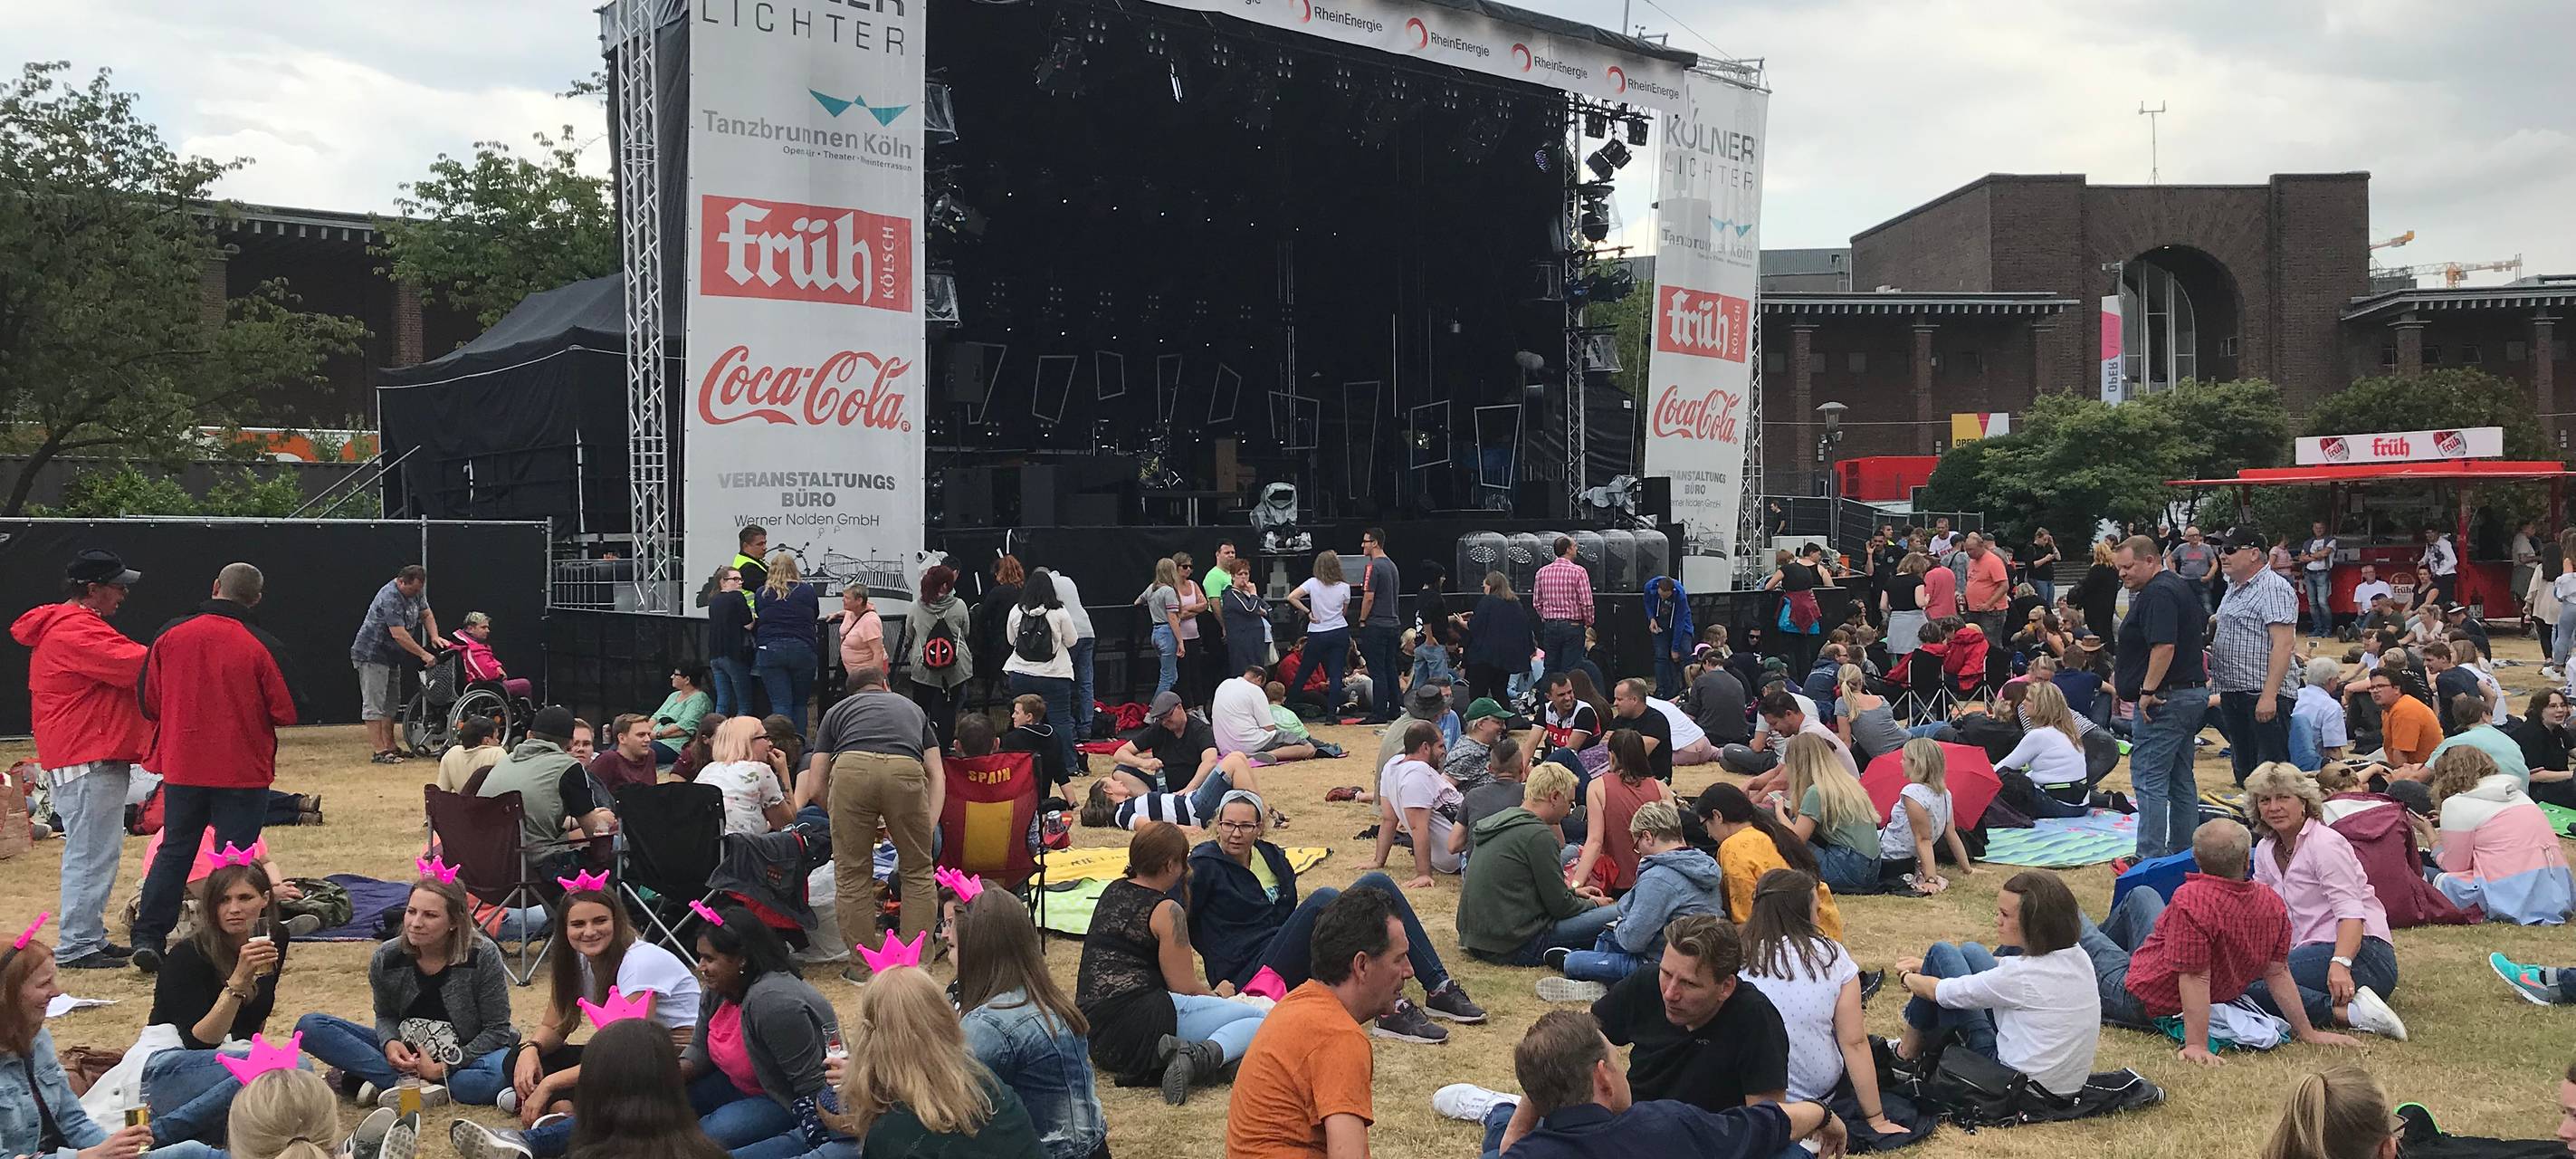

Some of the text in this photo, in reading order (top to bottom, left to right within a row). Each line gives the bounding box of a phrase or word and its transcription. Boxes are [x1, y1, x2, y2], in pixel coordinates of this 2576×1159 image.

[701, 0, 904, 56] LICHTER
[1314, 6, 1383, 33] RheinEnergie
[1430, 32, 1490, 57] RheinEnergie
[1534, 55, 1588, 80] RheinEnergie
[1627, 78, 1680, 100] RheinEnergie
[702, 109, 911, 159] Tanzbrunnen Köln
[824, 149, 854, 161] Theater
[1665, 152, 1753, 191] LICHTER
[717, 202, 873, 305] früh
[882, 226, 895, 300] KÖLSCH
[1666, 289, 1729, 359] früh
[1955, 438, 1977, 447] OP
[2371, 436, 2410, 458] früh
[718, 472, 895, 491] VERANSTALTUNGS
[1684, 483, 1706, 494] BÜRO
[781, 488, 836, 507] BÜRO
[734, 513, 880, 527] Werner Nolden GmbH
[968, 767, 1011, 785] SPAIN
